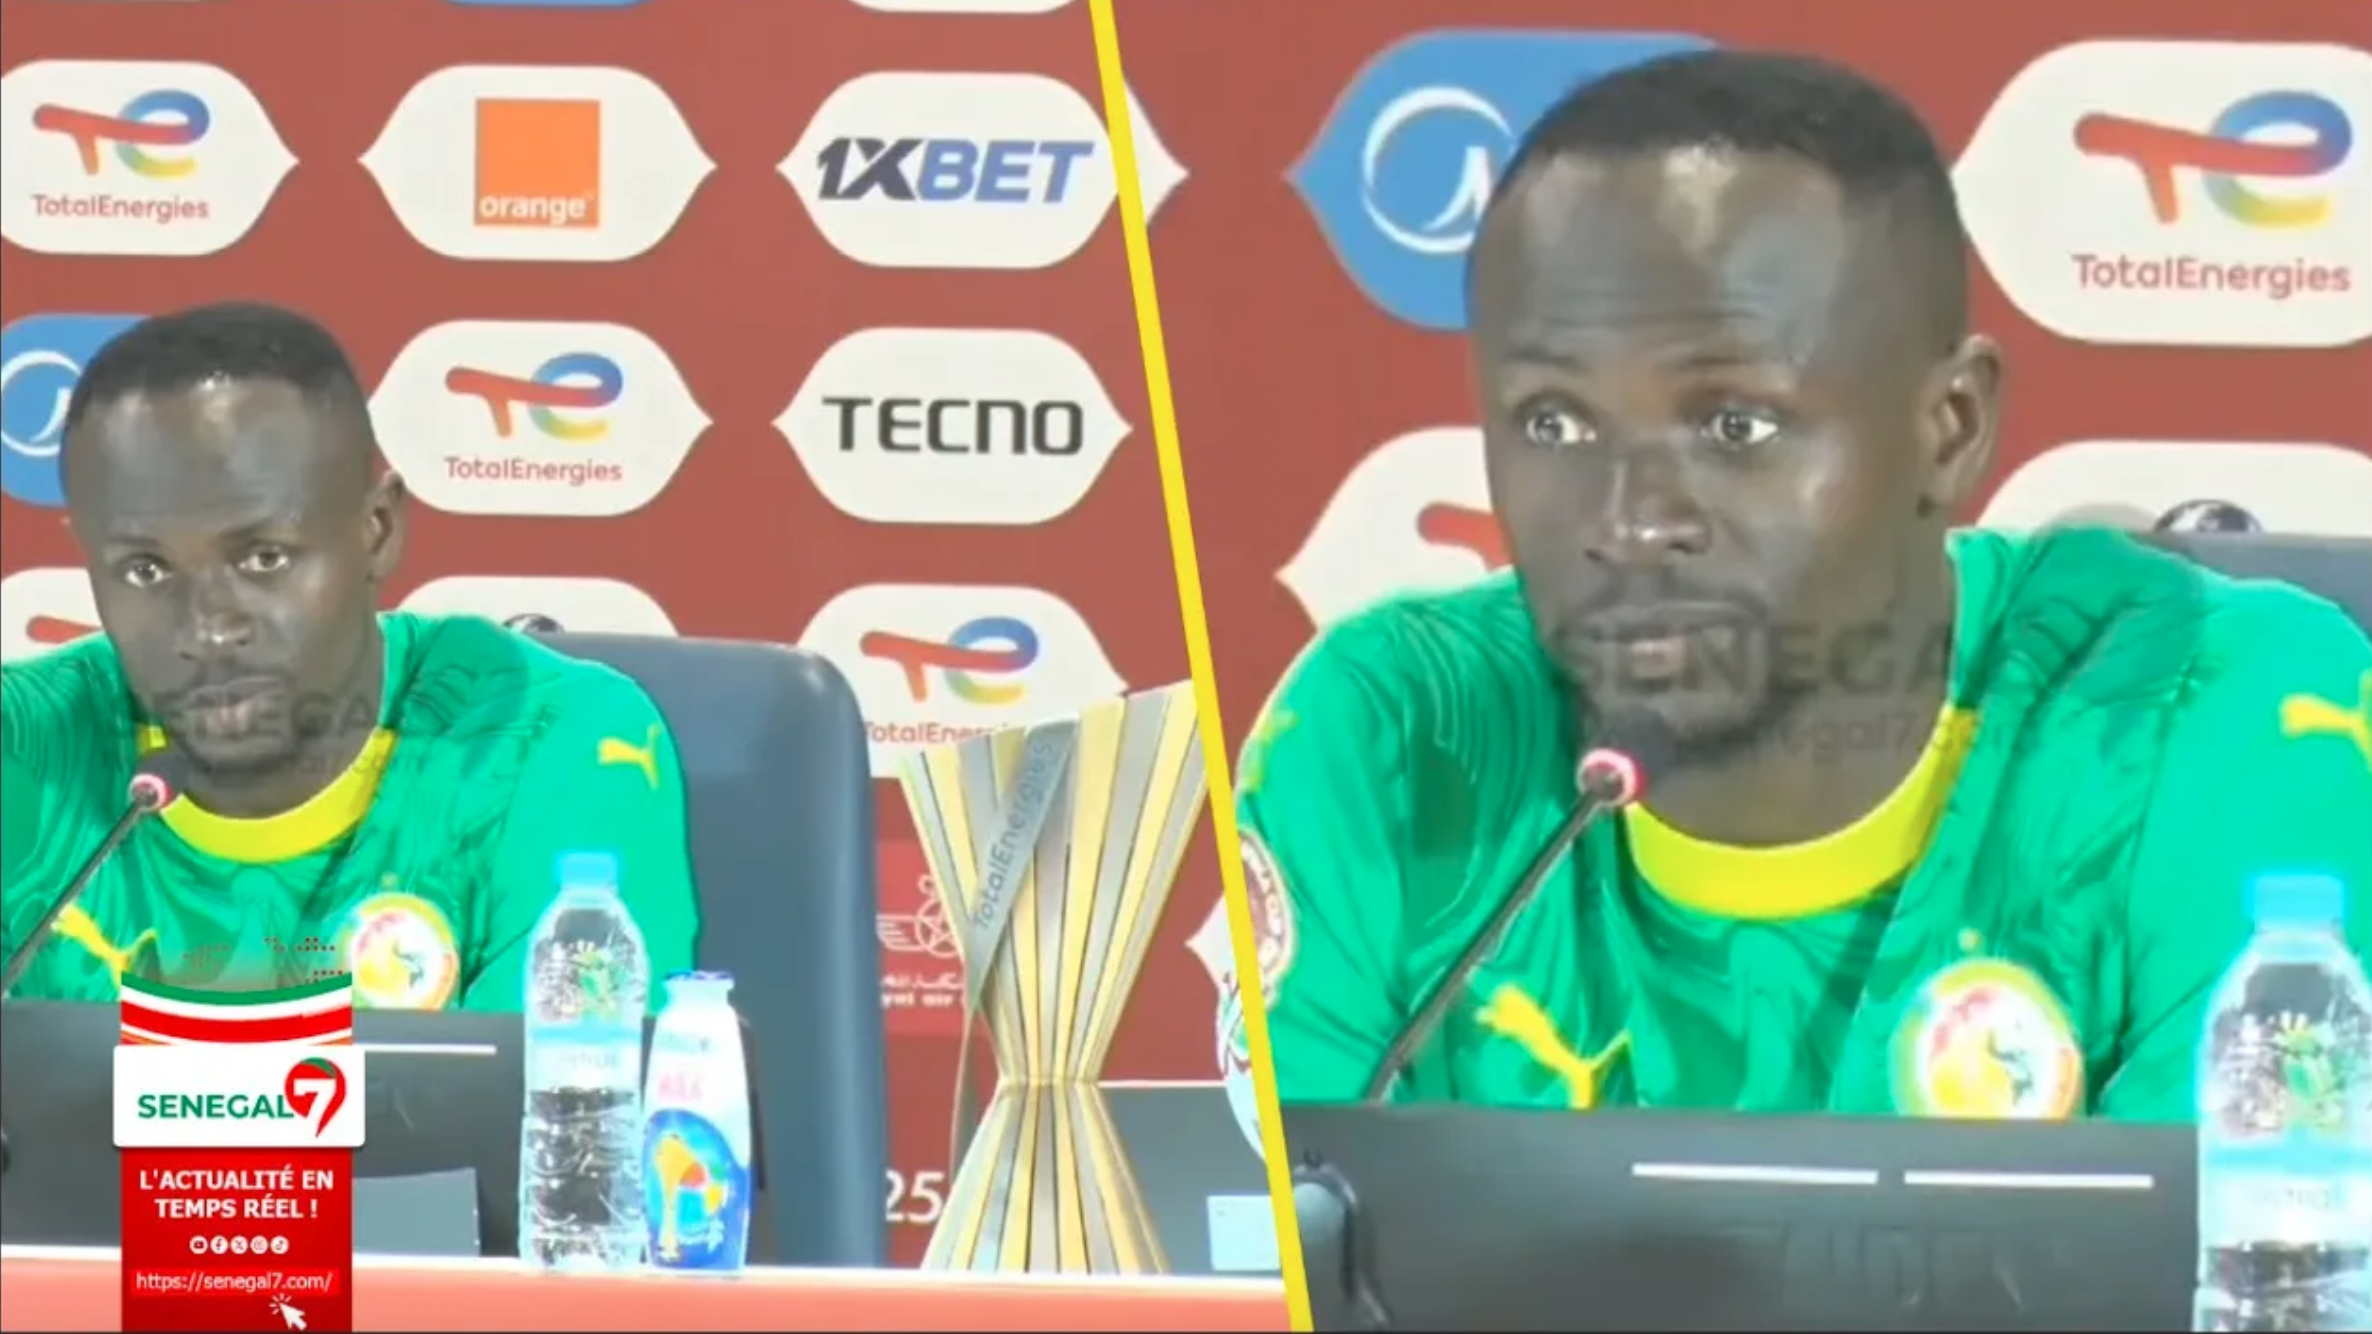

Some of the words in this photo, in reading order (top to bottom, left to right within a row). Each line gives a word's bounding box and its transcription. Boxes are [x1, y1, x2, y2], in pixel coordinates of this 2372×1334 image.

[815, 137, 1096, 204] 1XBET
[31, 193, 210, 224] TotalEnergies
[480, 195, 587, 225] orange
[2071, 254, 2352, 300] TotalEnergies
[821, 397, 1084, 456] TECNO
[443, 456, 624, 487] TotalEnergies
